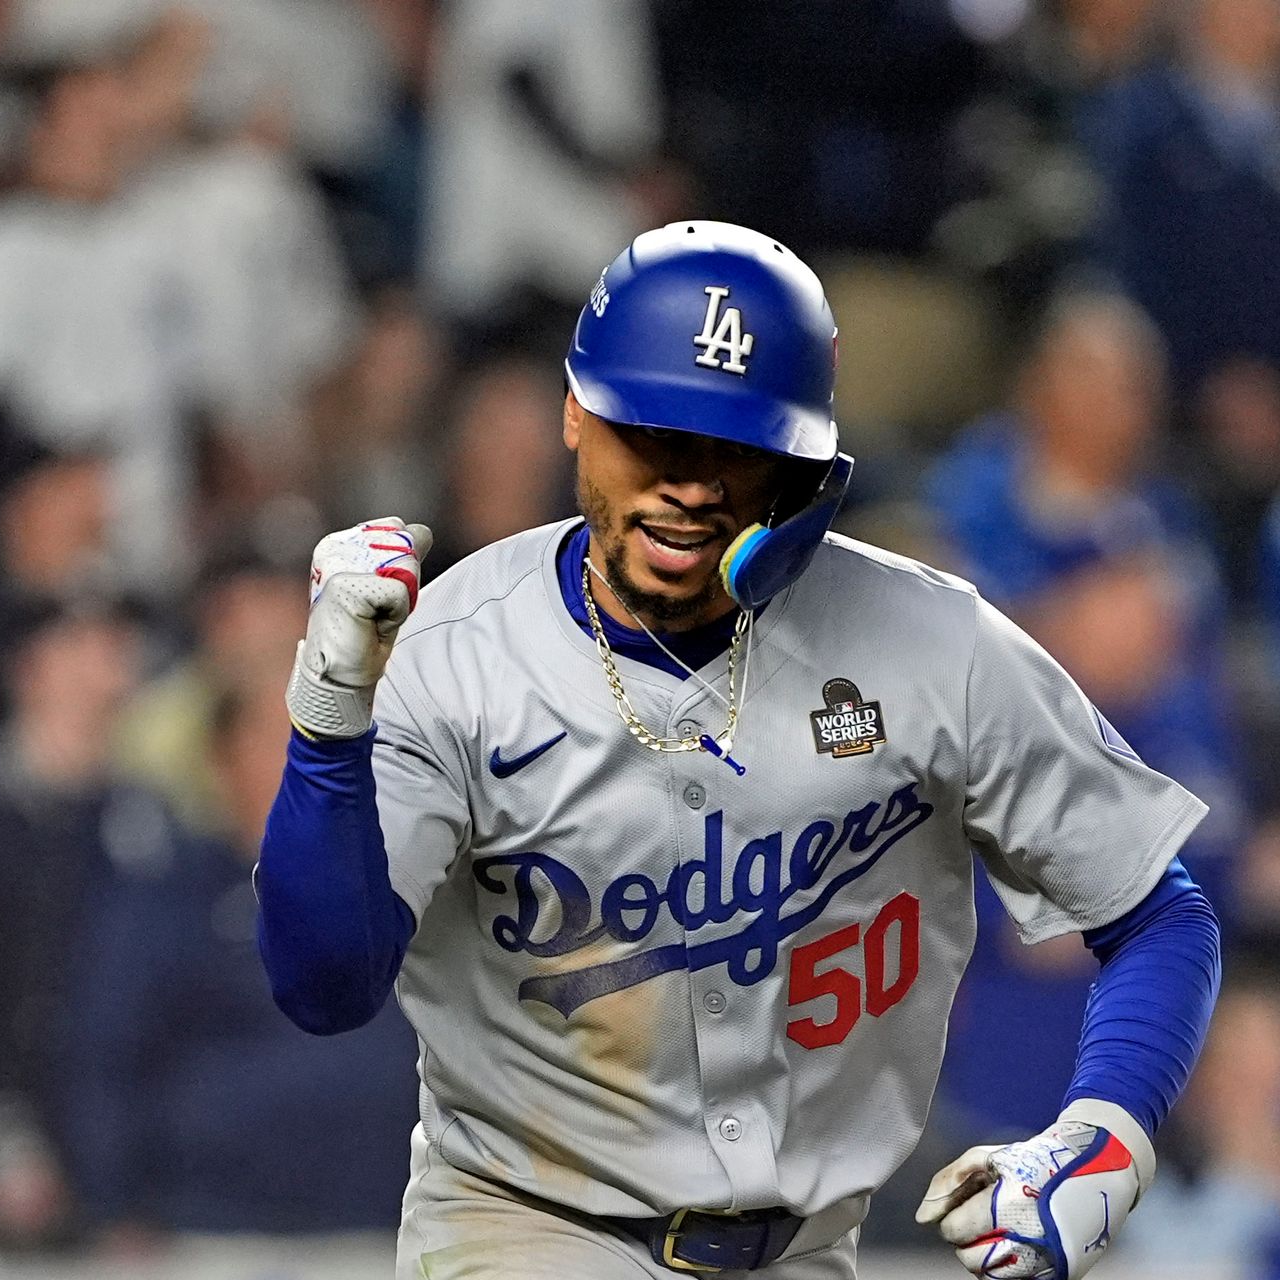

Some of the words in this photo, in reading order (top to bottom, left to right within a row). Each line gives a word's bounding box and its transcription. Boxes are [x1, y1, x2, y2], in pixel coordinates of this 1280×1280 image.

[693, 286, 754, 374] LA
[815, 708, 877, 731] WORLD
[820, 721, 877, 743] SERIES
[472, 781, 934, 988] Dodgers
[786, 890, 920, 1050] 50
